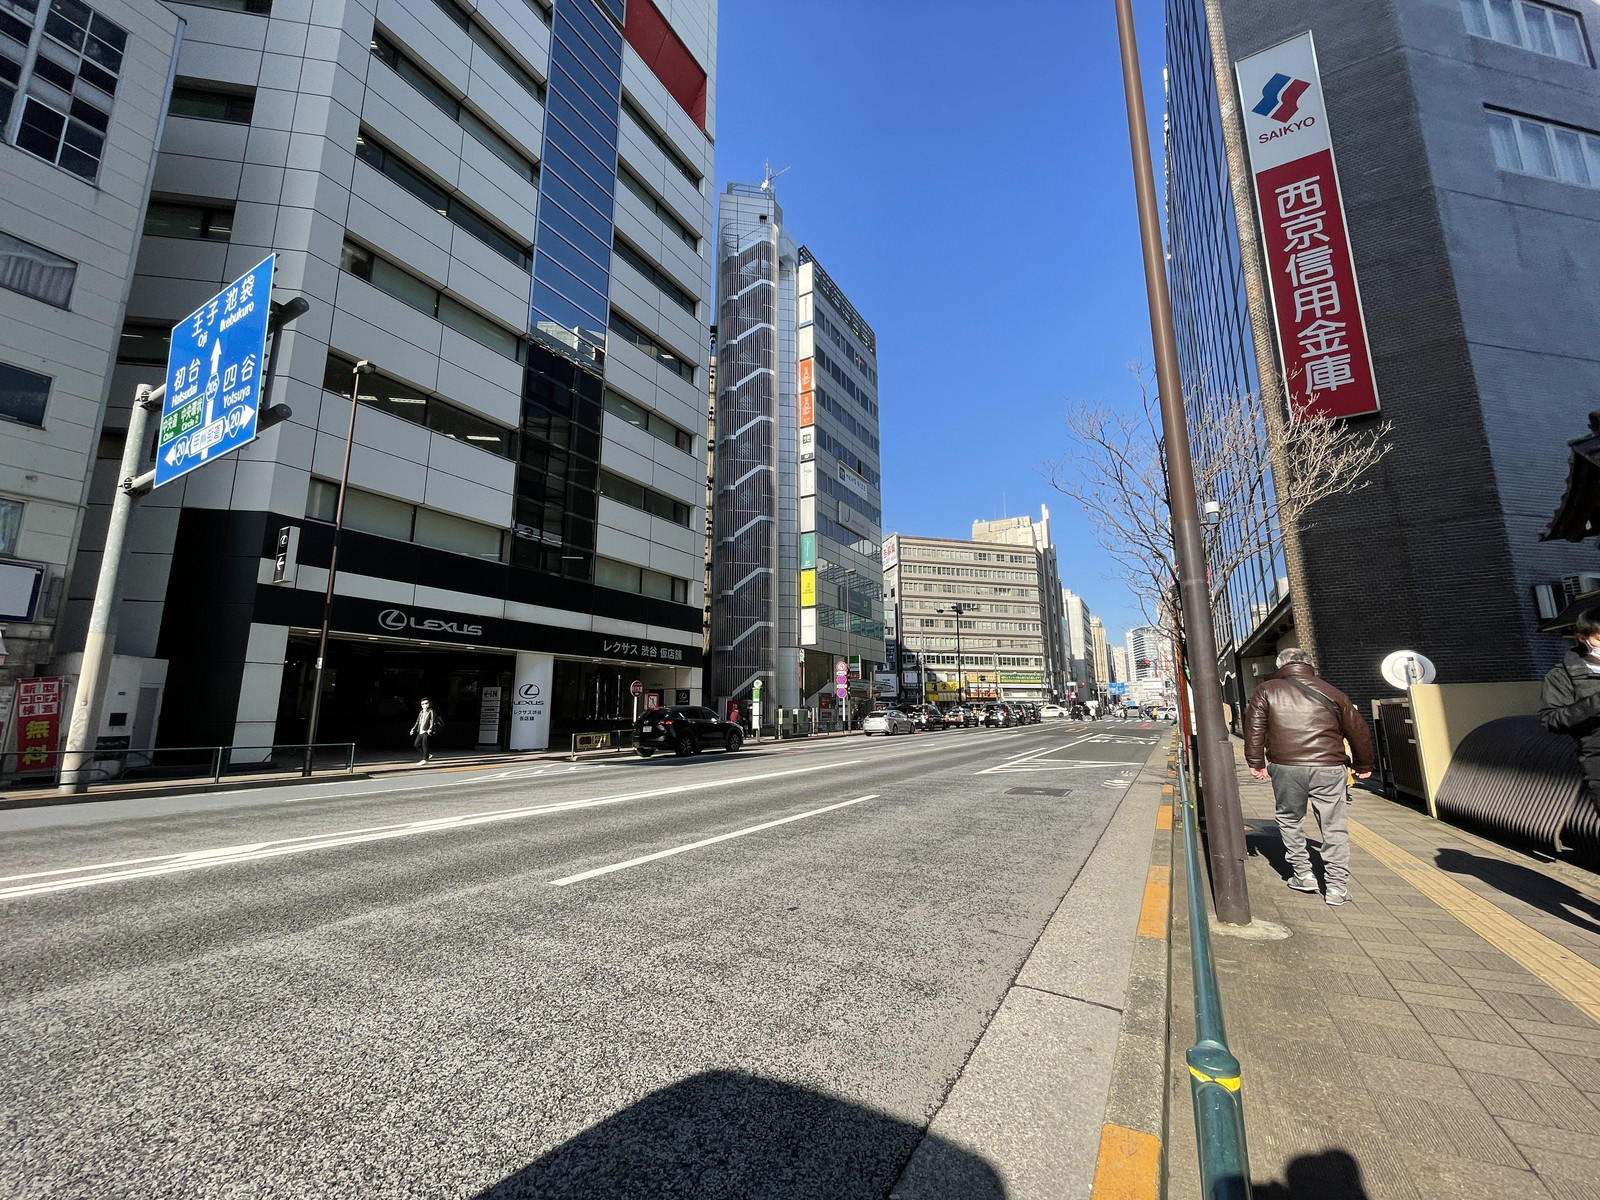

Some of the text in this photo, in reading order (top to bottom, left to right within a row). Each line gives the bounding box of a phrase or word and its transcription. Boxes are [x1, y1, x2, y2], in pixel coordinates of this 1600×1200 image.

[1258, 115, 1316, 145] SAIKYO
[1274, 175, 1355, 396] 西京信用金庫
[191, 274, 255, 338] 王子 池袋
[197, 301, 255, 348] Oji Ikebukuro
[173, 357, 201, 392] 初台
[222, 353, 257, 393] 四谷
[171, 381, 199, 408] Hatsudai
[223, 385, 251, 409] Yotsuya
[230, 410, 241, 429] 20
[177, 441, 186, 458] 20
[409, 616, 483, 636] LEXUS
[603, 640, 683, 661] レクサス 渋谷 仮店舗
[21, 694, 58, 704] コロナ
[489, 690, 498, 698] IN
[22, 720, 50, 765] 無料
